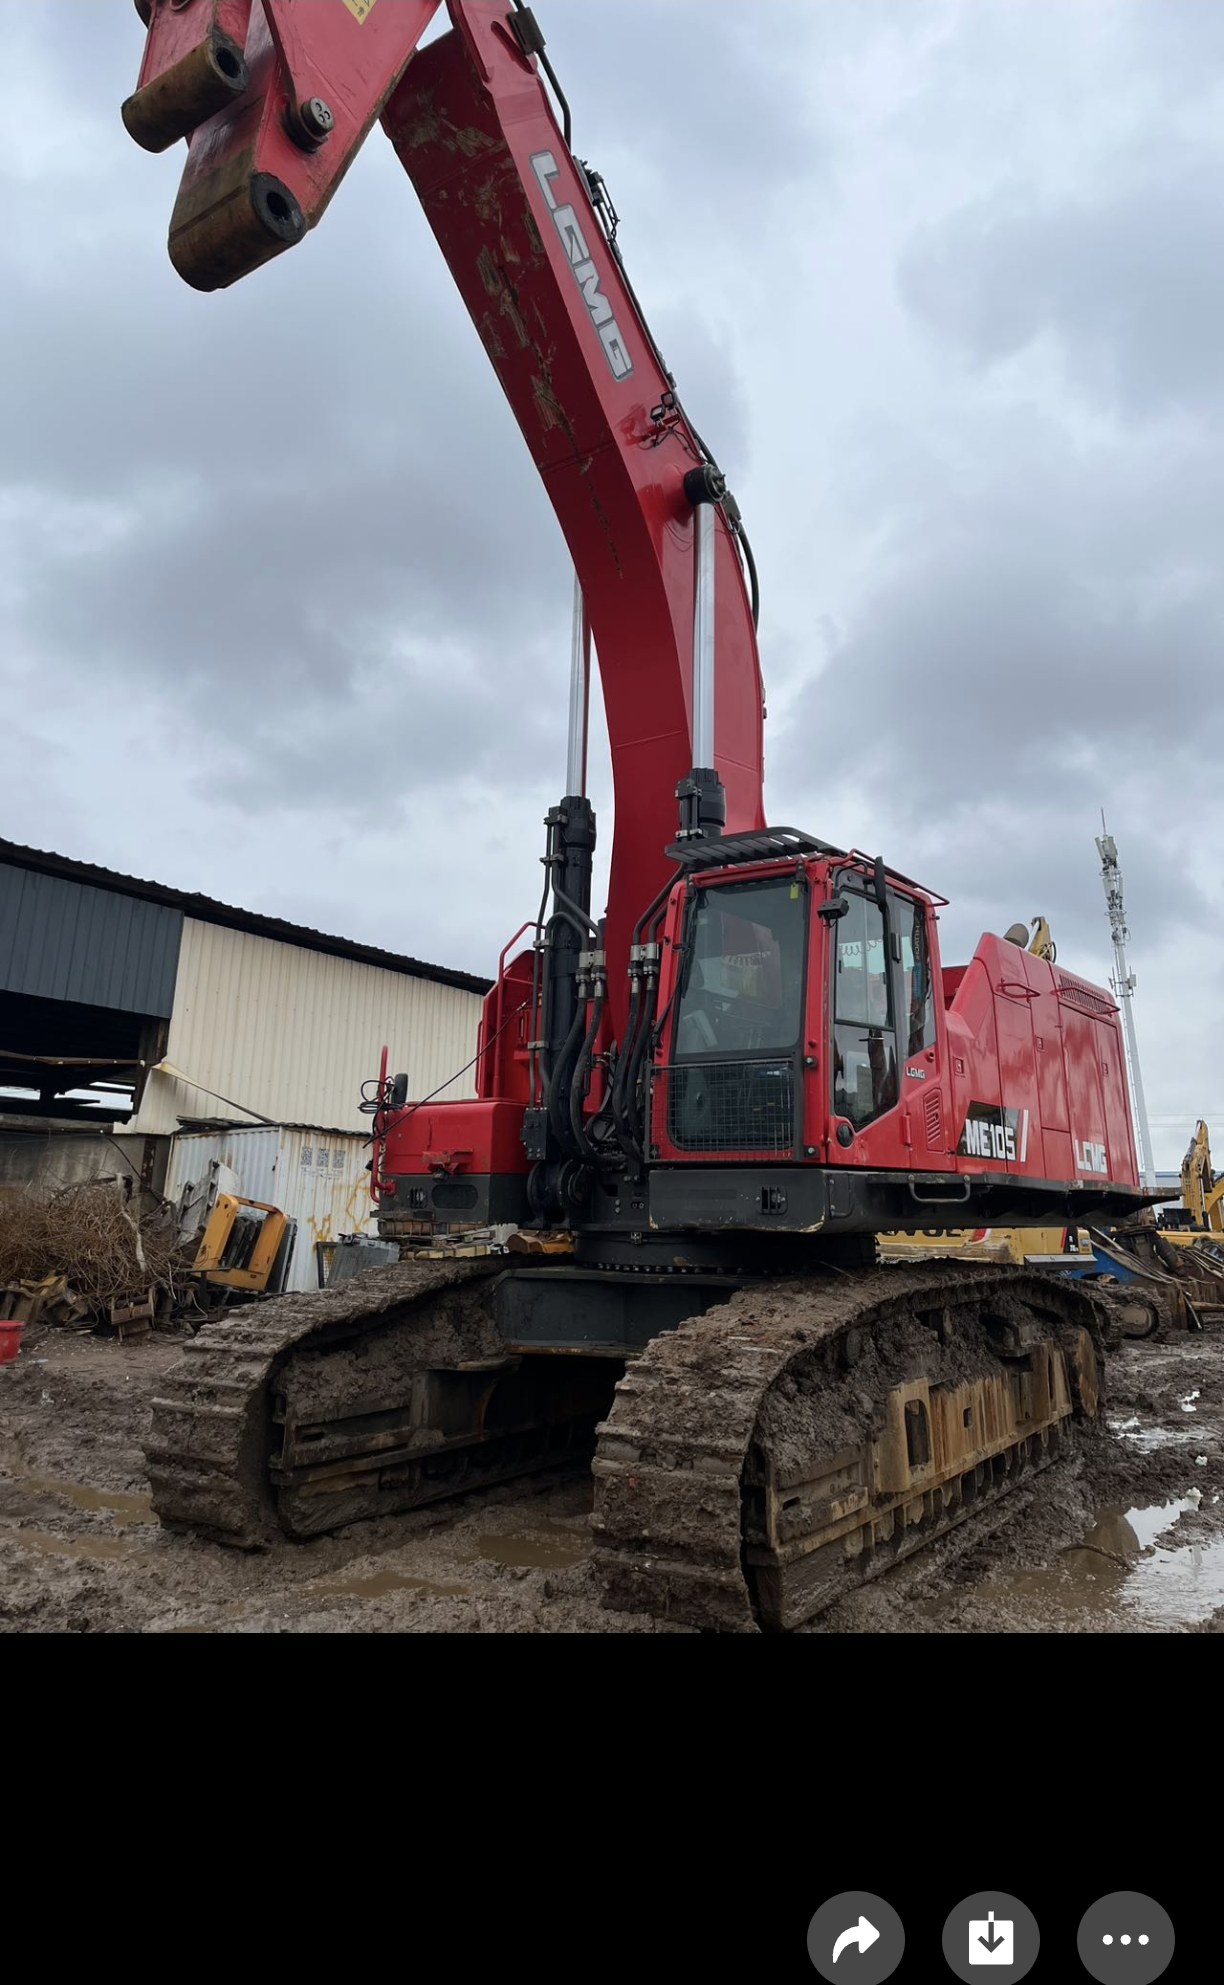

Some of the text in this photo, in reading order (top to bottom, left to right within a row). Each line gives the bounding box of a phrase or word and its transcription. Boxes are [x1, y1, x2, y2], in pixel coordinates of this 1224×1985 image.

[530, 150, 634, 382] LGMG
[906, 1066, 926, 1079] LGMG
[965, 1118, 1016, 1161] ME105
